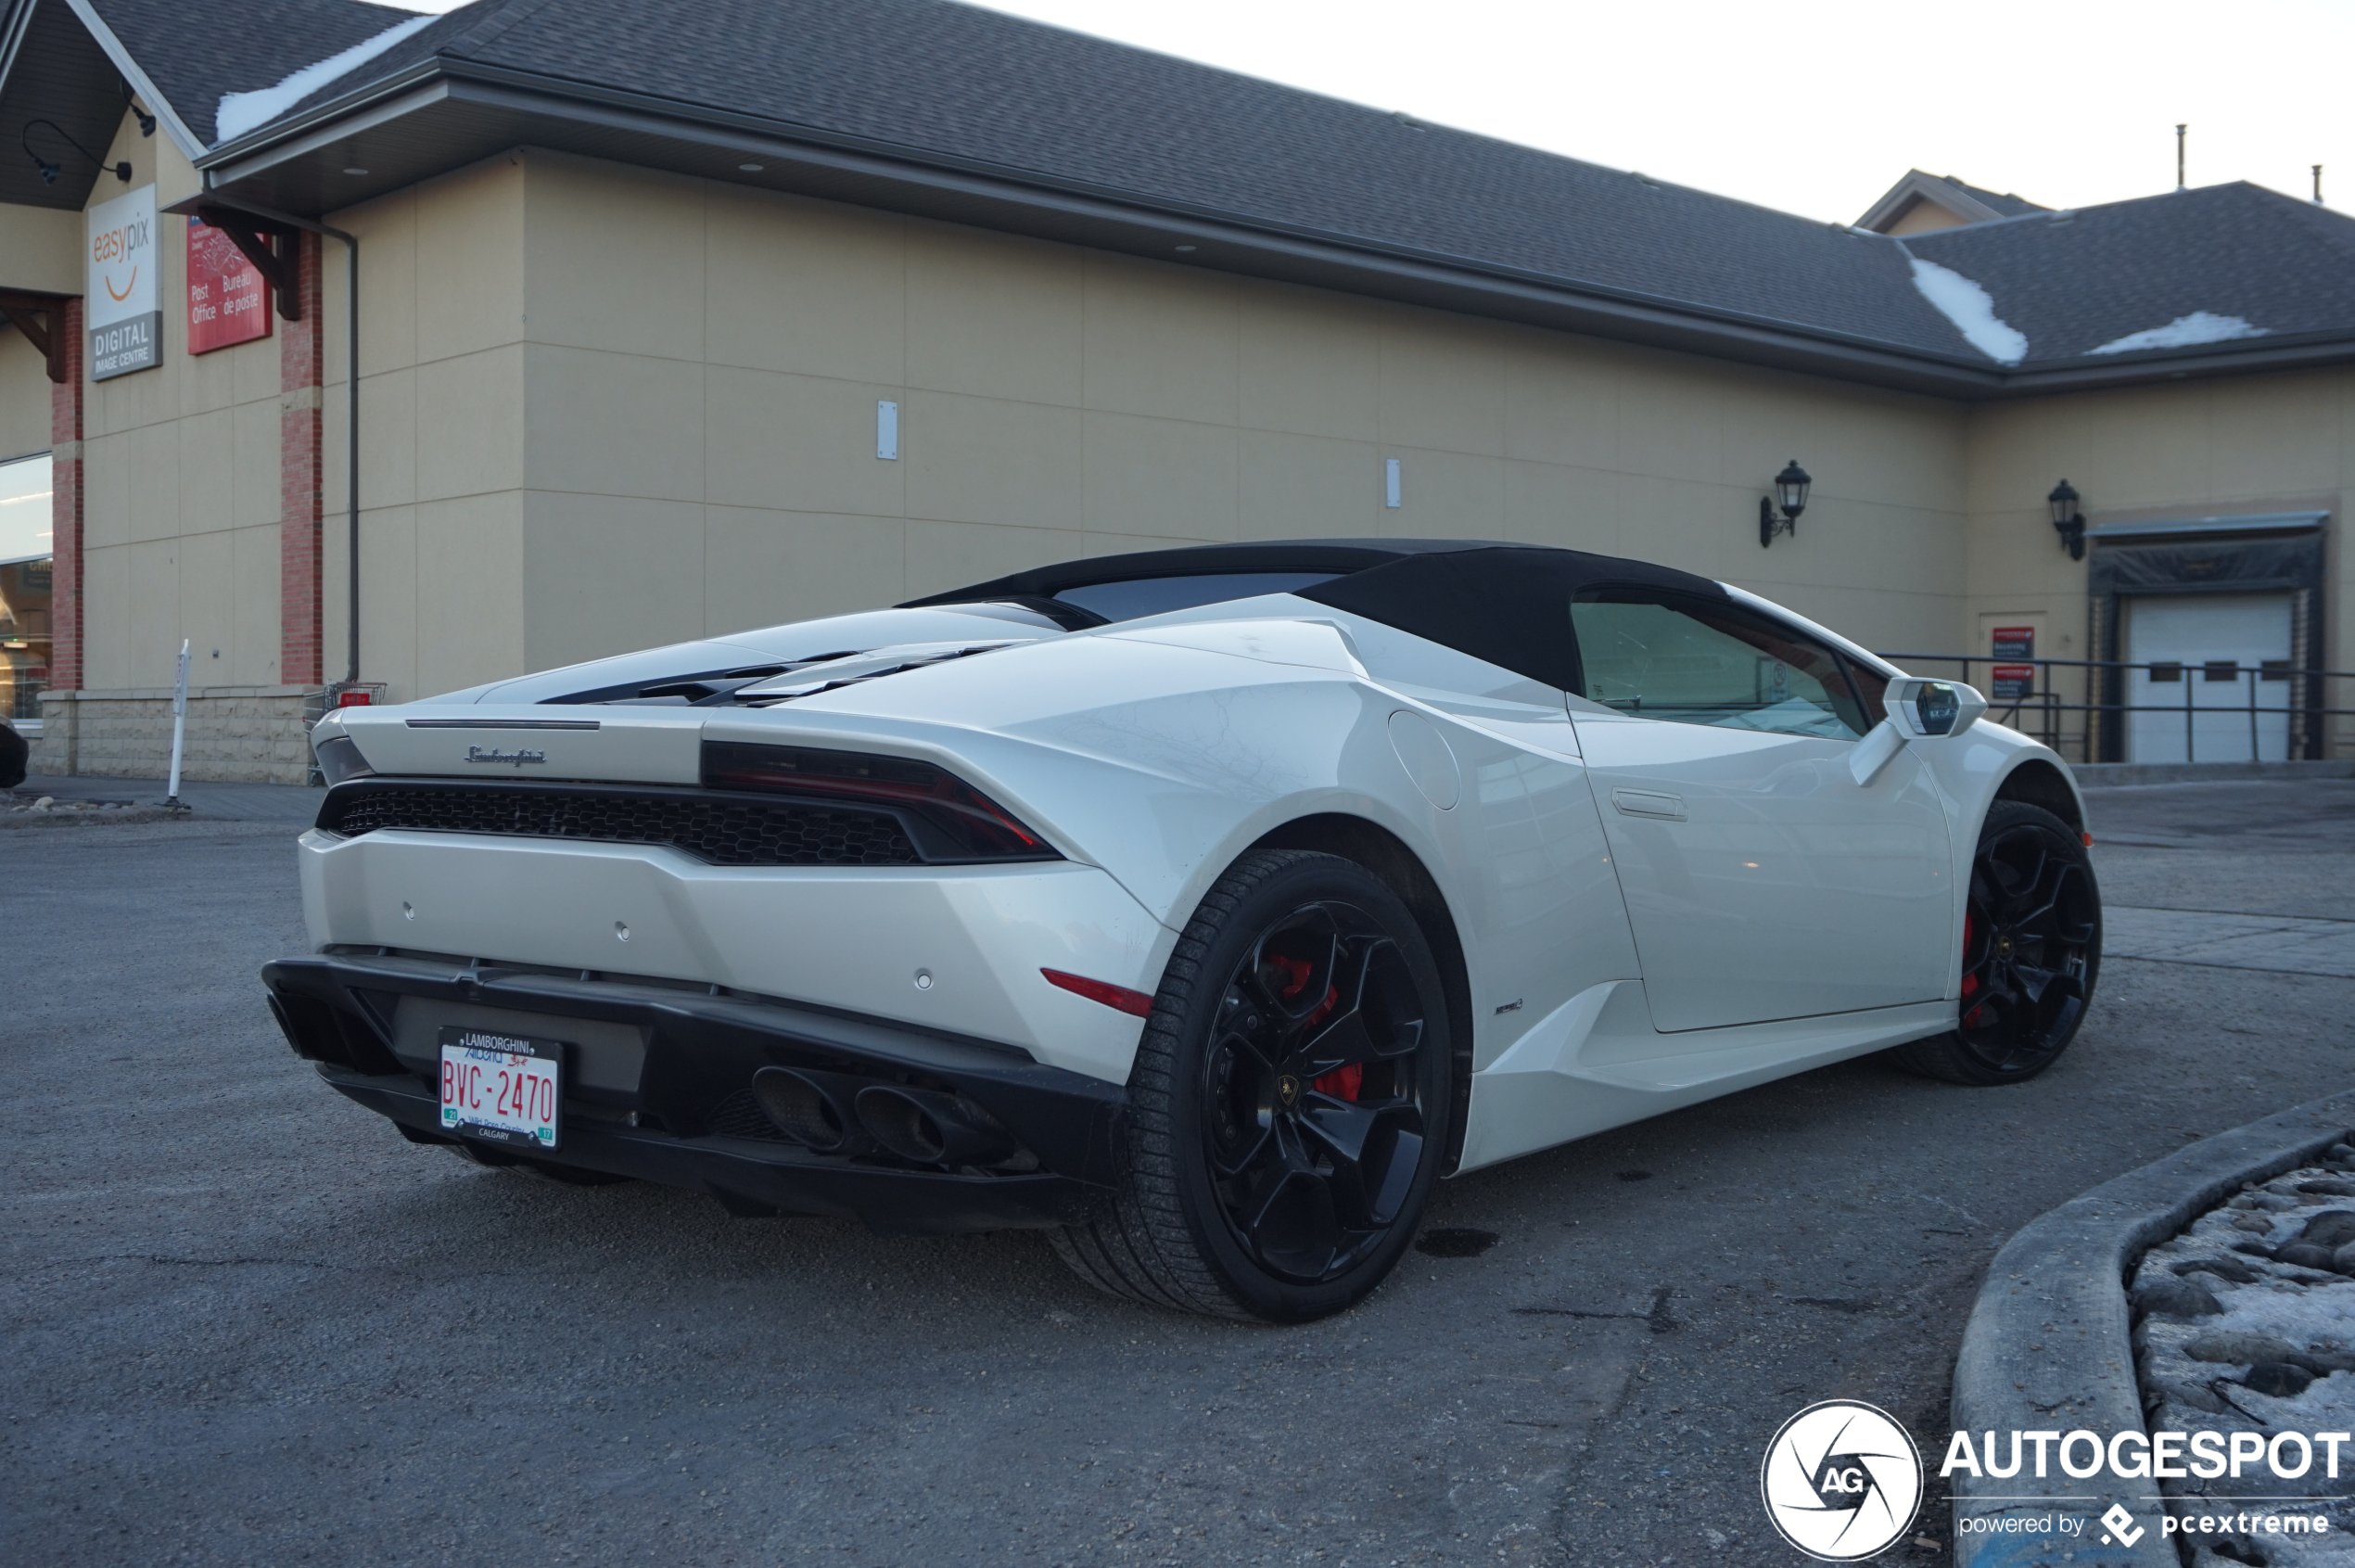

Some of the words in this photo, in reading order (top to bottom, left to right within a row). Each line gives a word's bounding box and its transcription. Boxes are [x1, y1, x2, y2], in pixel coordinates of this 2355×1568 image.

[94, 211, 148, 263] easypix
[192, 283, 209, 301] Post
[223, 273, 251, 293] Bureau
[192, 303, 216, 324] Office
[223, 297, 235, 315] de
[236, 292, 259, 316] poste
[95, 322, 148, 356] DIGITAL
[95, 354, 118, 373] IMAGE
[119, 346, 148, 367] CENTRE
[465, 1032, 529, 1054] LAMBORGHINI
[443, 1060, 553, 1123] BVC-2470
[449, 1110, 456, 1119] 21
[478, 1128, 510, 1141] CALGARY
[542, 1128, 551, 1139] 17
